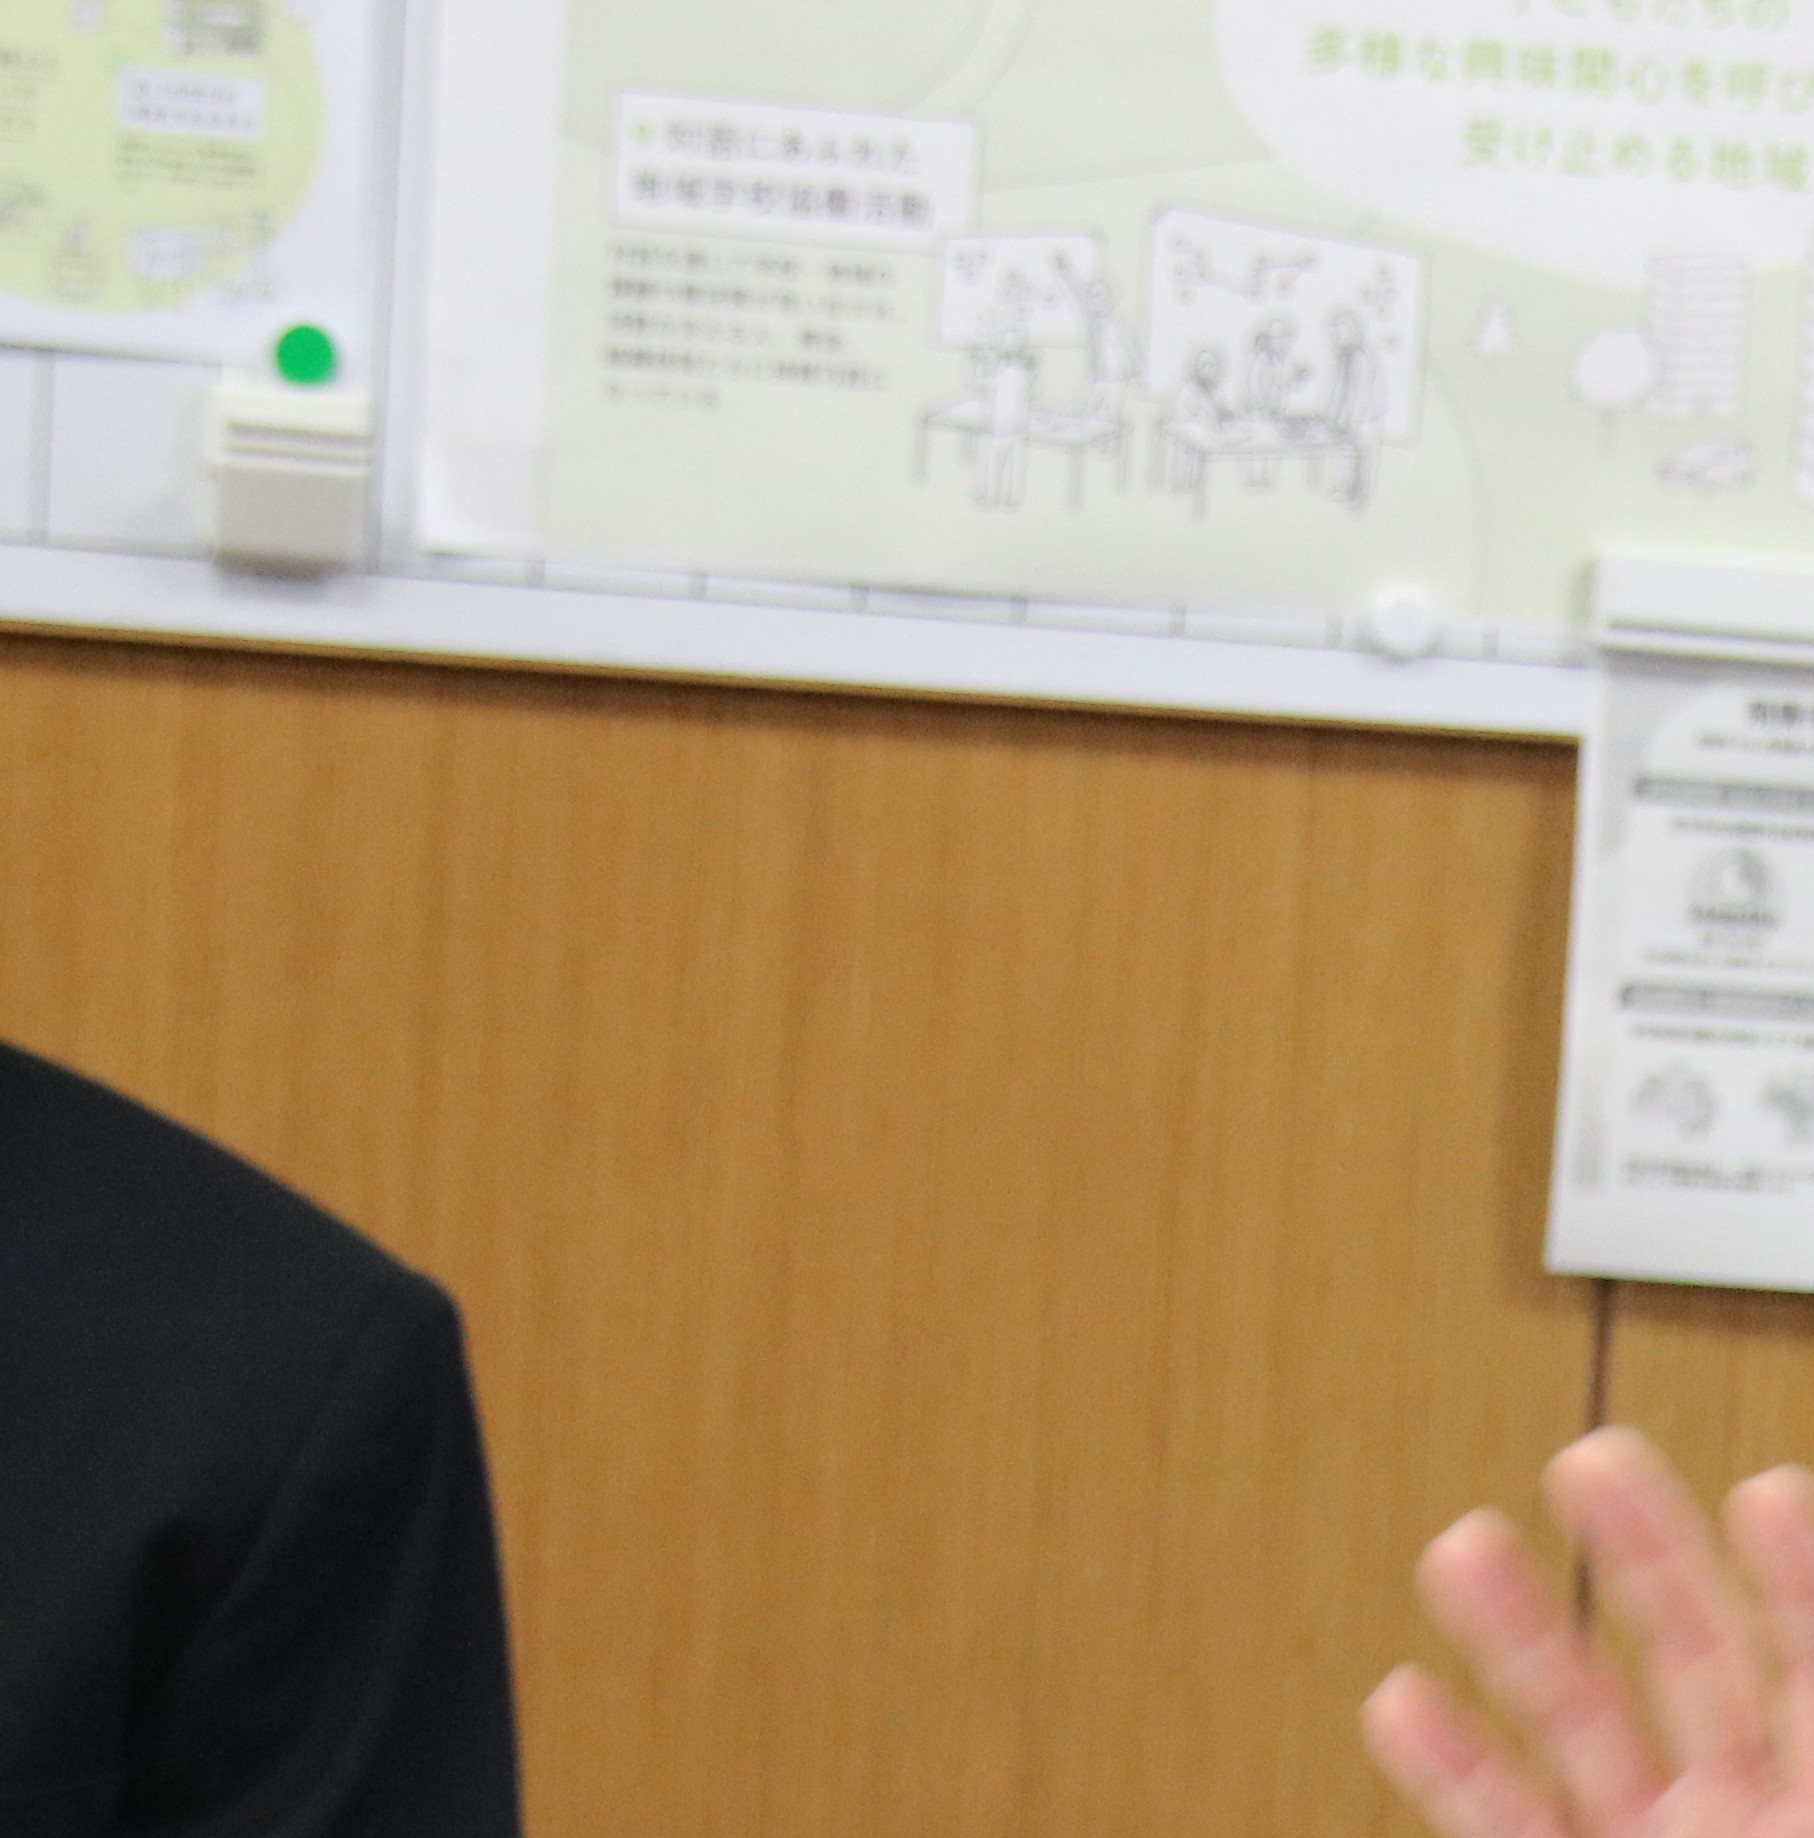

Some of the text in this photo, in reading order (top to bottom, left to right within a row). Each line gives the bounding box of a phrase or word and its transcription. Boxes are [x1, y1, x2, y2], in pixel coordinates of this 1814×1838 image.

[1459, 112, 1812, 194] 受け止める地域
